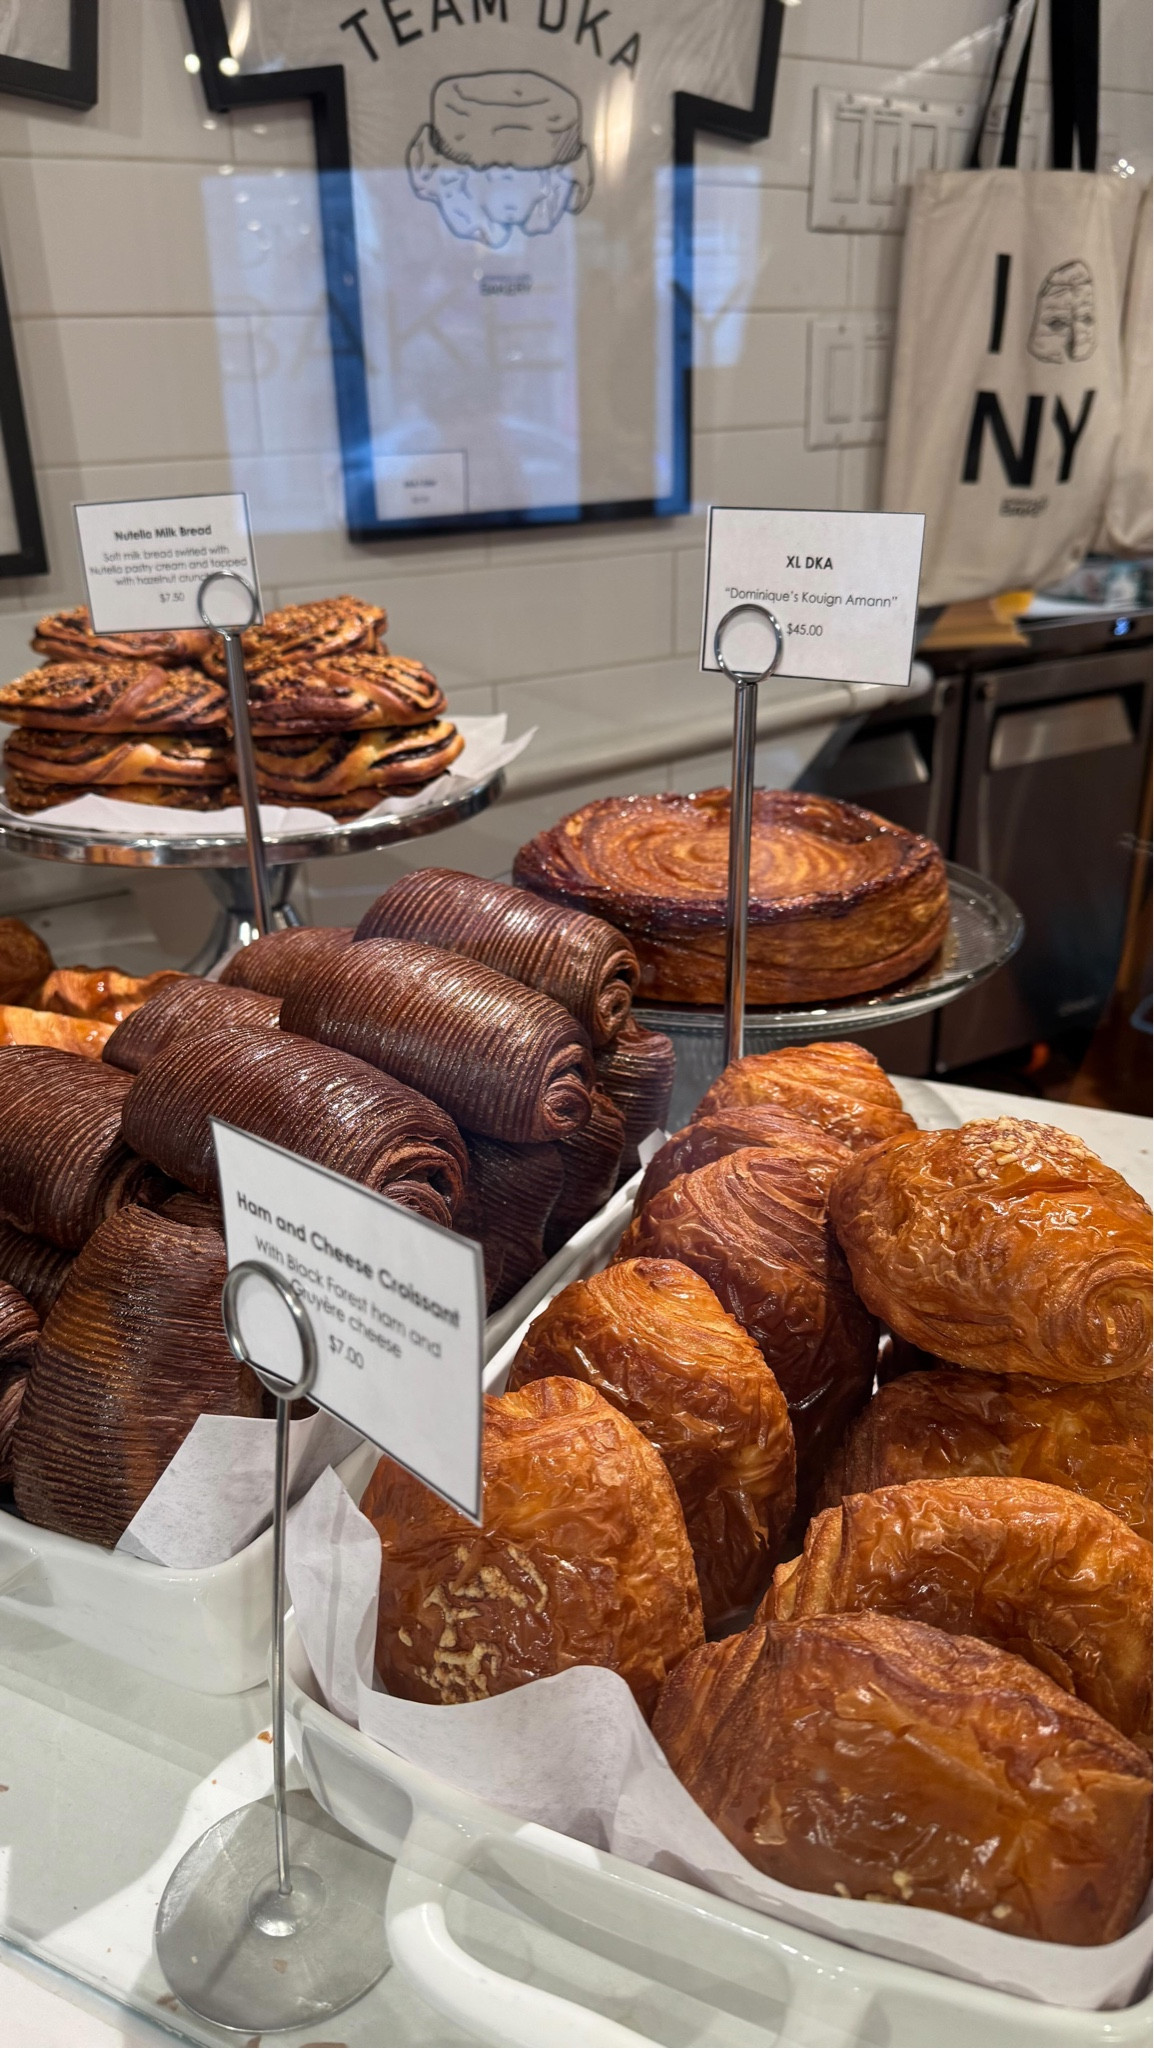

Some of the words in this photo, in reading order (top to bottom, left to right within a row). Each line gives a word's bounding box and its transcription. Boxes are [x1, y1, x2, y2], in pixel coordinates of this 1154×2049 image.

[538, 0, 643, 81] DKA
[988, 253, 1011, 354] I
[960, 388, 1097, 489] NY
[113, 529, 153, 541] Nutella
[155, 527, 178, 539] Milk
[180, 524, 212, 537] Bread
[103, 551, 122, 562] Soft
[123, 551, 141, 561] milk
[143, 549, 173, 560] bread
[175, 547, 208, 558] swirled
[209, 544, 230, 555] with
[786, 556, 801, 569] XL
[805, 557, 834, 570] DKA
[89, 565, 123, 576] Nutella
[125, 563, 152, 575] pastry
[155, 561, 187, 572] cream
[189, 559, 209, 570] and
[210, 556, 248, 569] topped
[115, 575, 135, 586] with
[136, 573, 177, 586] hazelnut
[178, 571, 211, 583] crunc
[159, 592, 185, 604] $7.50
[801, 591, 842, 608] Kouign
[786, 623, 823, 637] $45.00
[236, 1190, 273, 1225] Ham
[275, 1216, 307, 1244] and
[310, 1230, 373, 1280] Cheese
[377, 1267, 461, 1330] Croissant
[255, 1234, 285, 1266] With
[286, 1253, 325, 1288] Black
[326, 1276, 368, 1314] Forest
[370, 1301, 407, 1338] ham
[408, 1328, 442, 1360] and
[291, 1277, 346, 1323] Gruyère
[347, 1315, 403, 1360] cheese
[328, 1333, 365, 1371] $7.00
